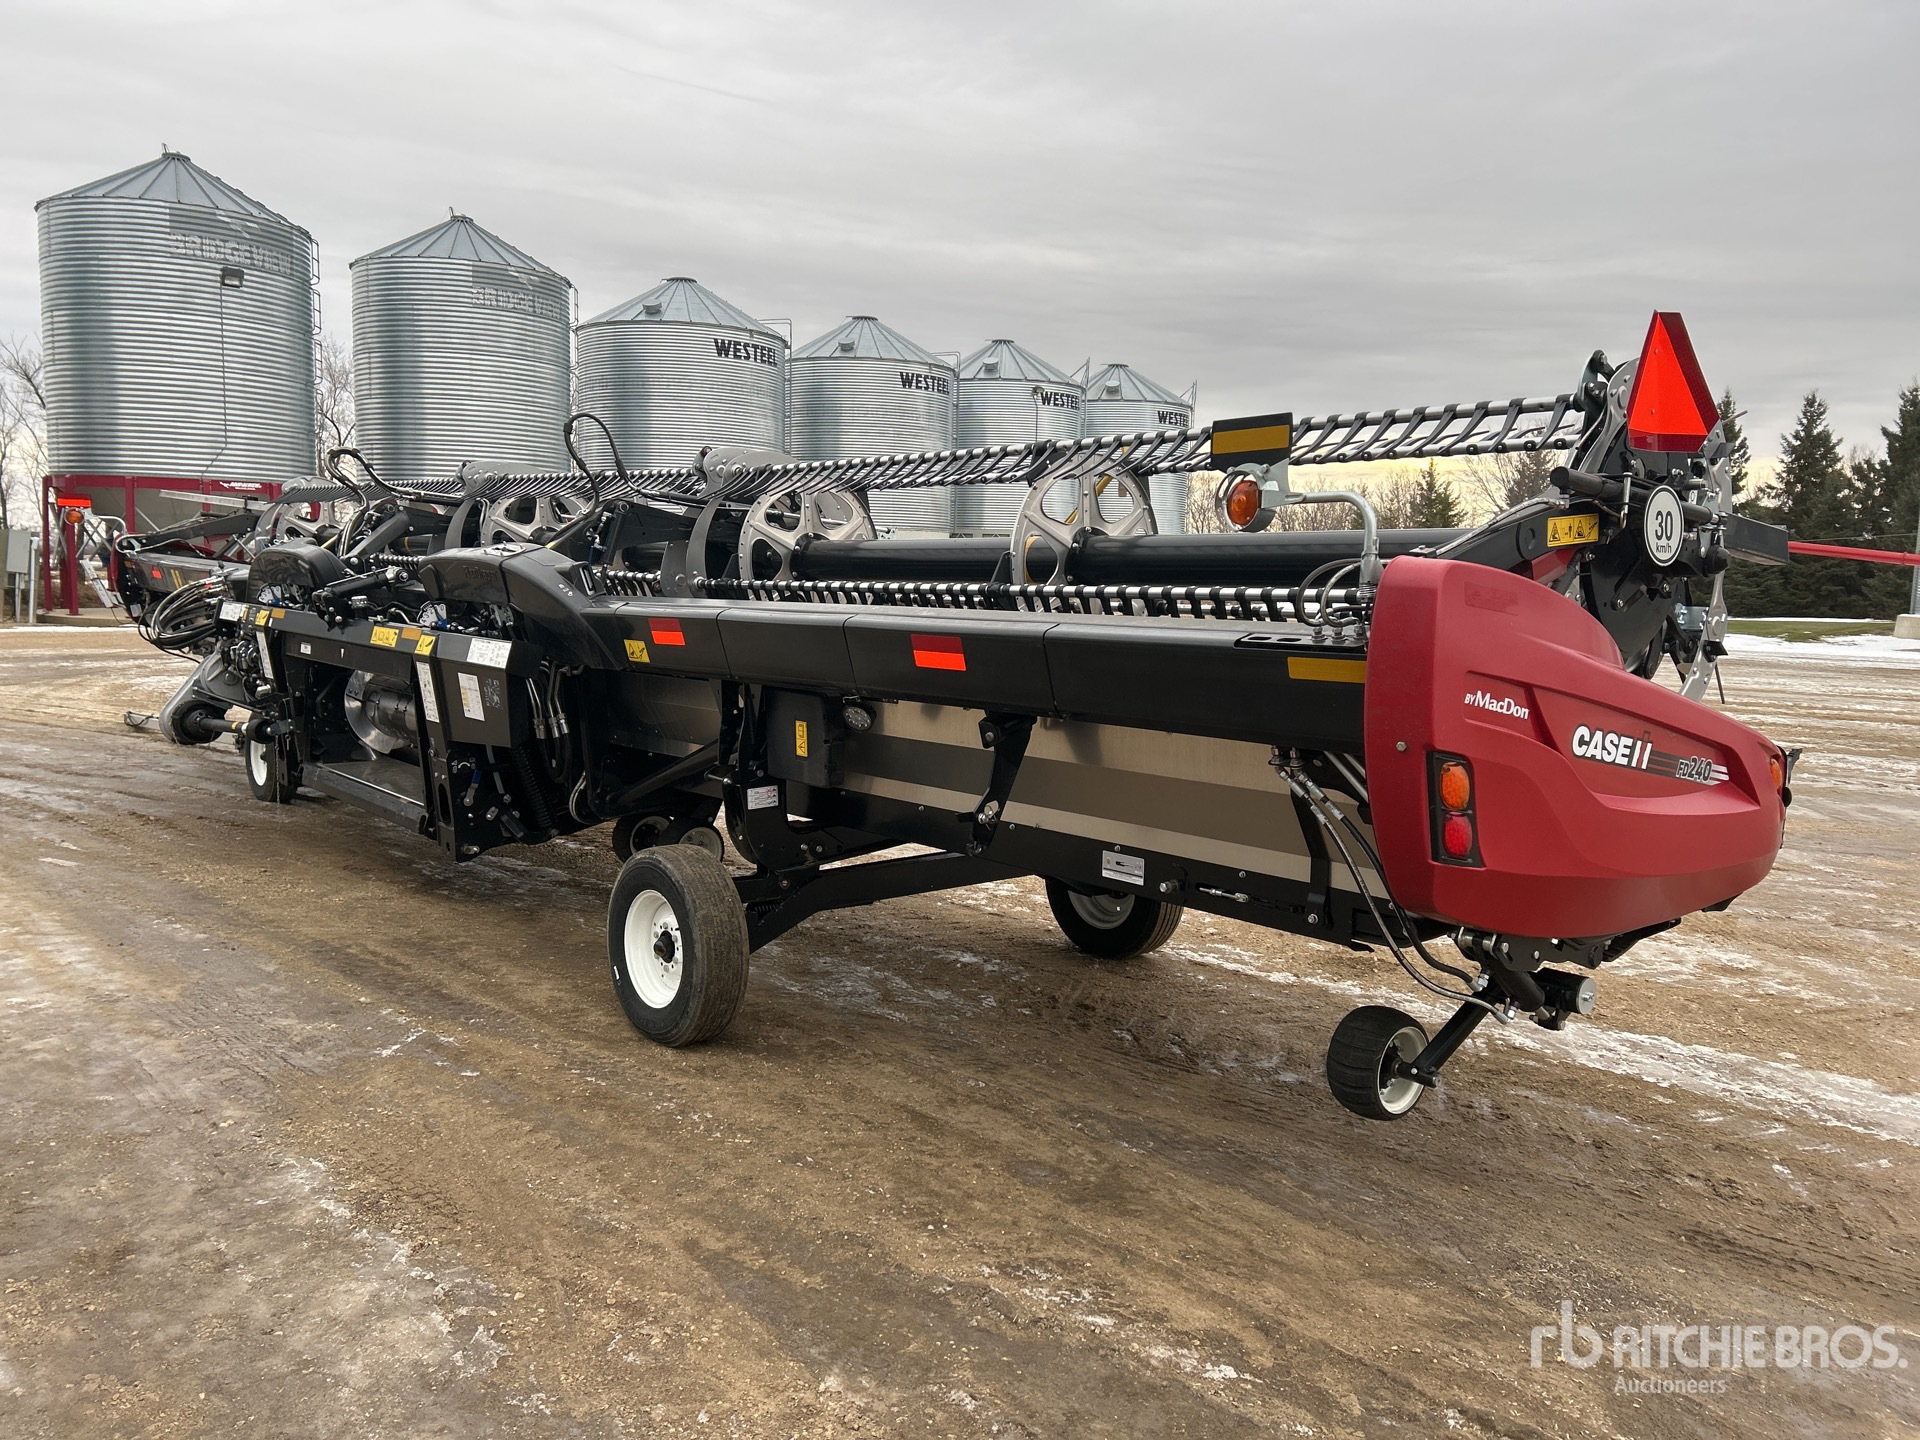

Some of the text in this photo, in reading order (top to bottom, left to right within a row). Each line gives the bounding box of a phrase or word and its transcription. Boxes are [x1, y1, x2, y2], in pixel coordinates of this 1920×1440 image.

[713, 337, 778, 368] WESTEEL
[1655, 510, 1674, 541] 30
[1656, 542, 1672, 553] km/h
[1464, 690, 1530, 719] BY MacDon
[1572, 725, 1634, 766] CASE
[1675, 756, 1713, 782] FD240
